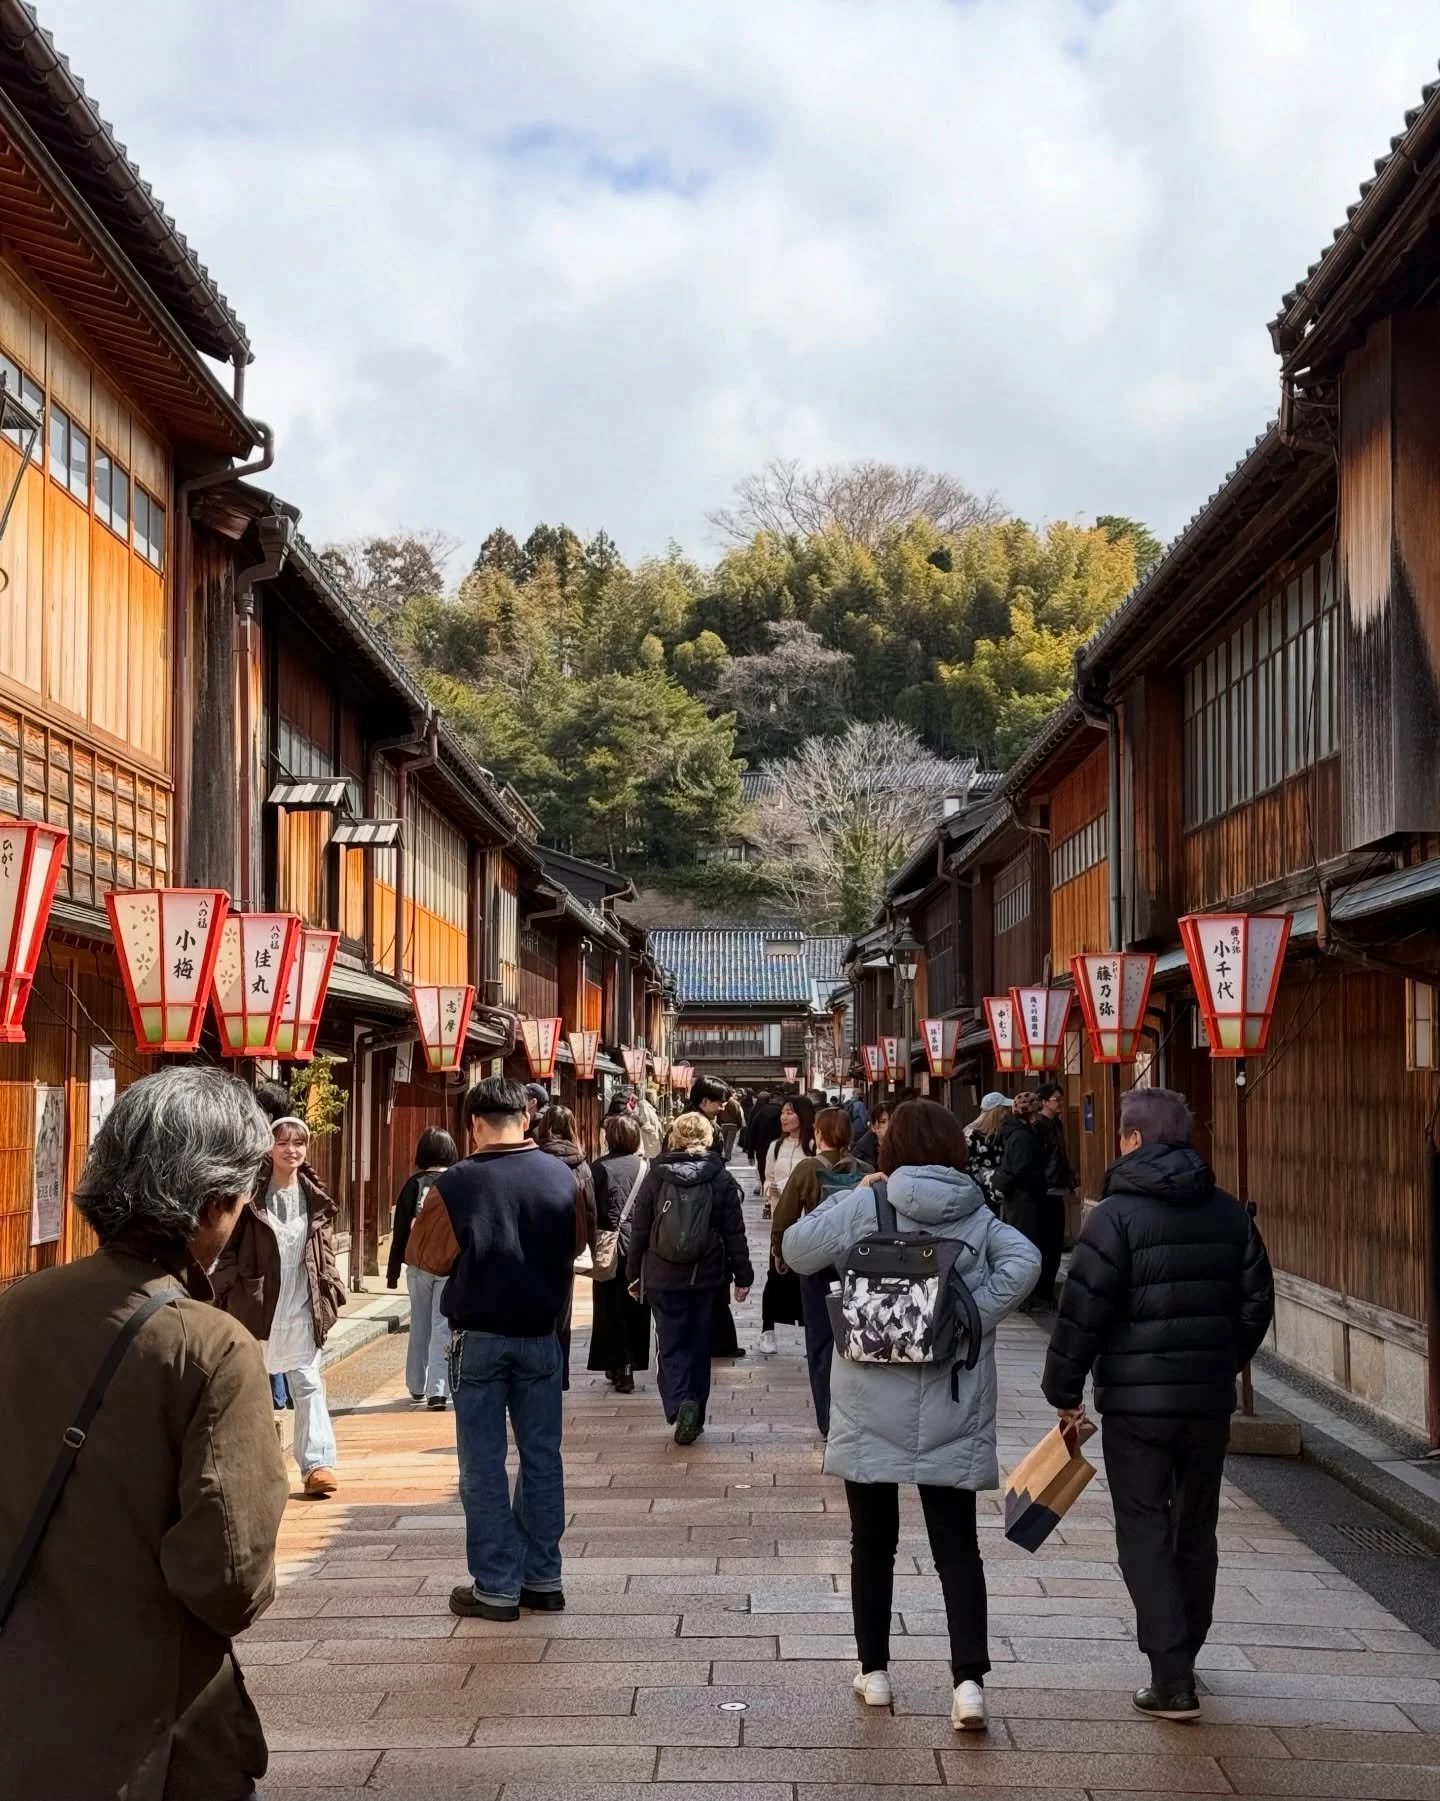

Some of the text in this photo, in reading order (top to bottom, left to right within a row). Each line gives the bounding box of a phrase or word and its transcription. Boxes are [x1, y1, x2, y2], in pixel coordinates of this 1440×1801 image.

[2, 839, 14, 878] ひがし
[173, 928, 196, 980] 小梅
[1230, 926, 1241, 955] 藤乃弥
[251, 948, 272, 994] 佳丸
[1213, 939, 1235, 1000] 小千代
[1096, 965, 1115, 1017] 藤乃弥
[444, 1000, 457, 1033] 志摩
[997, 1009, 1008, 1039] 中むら
